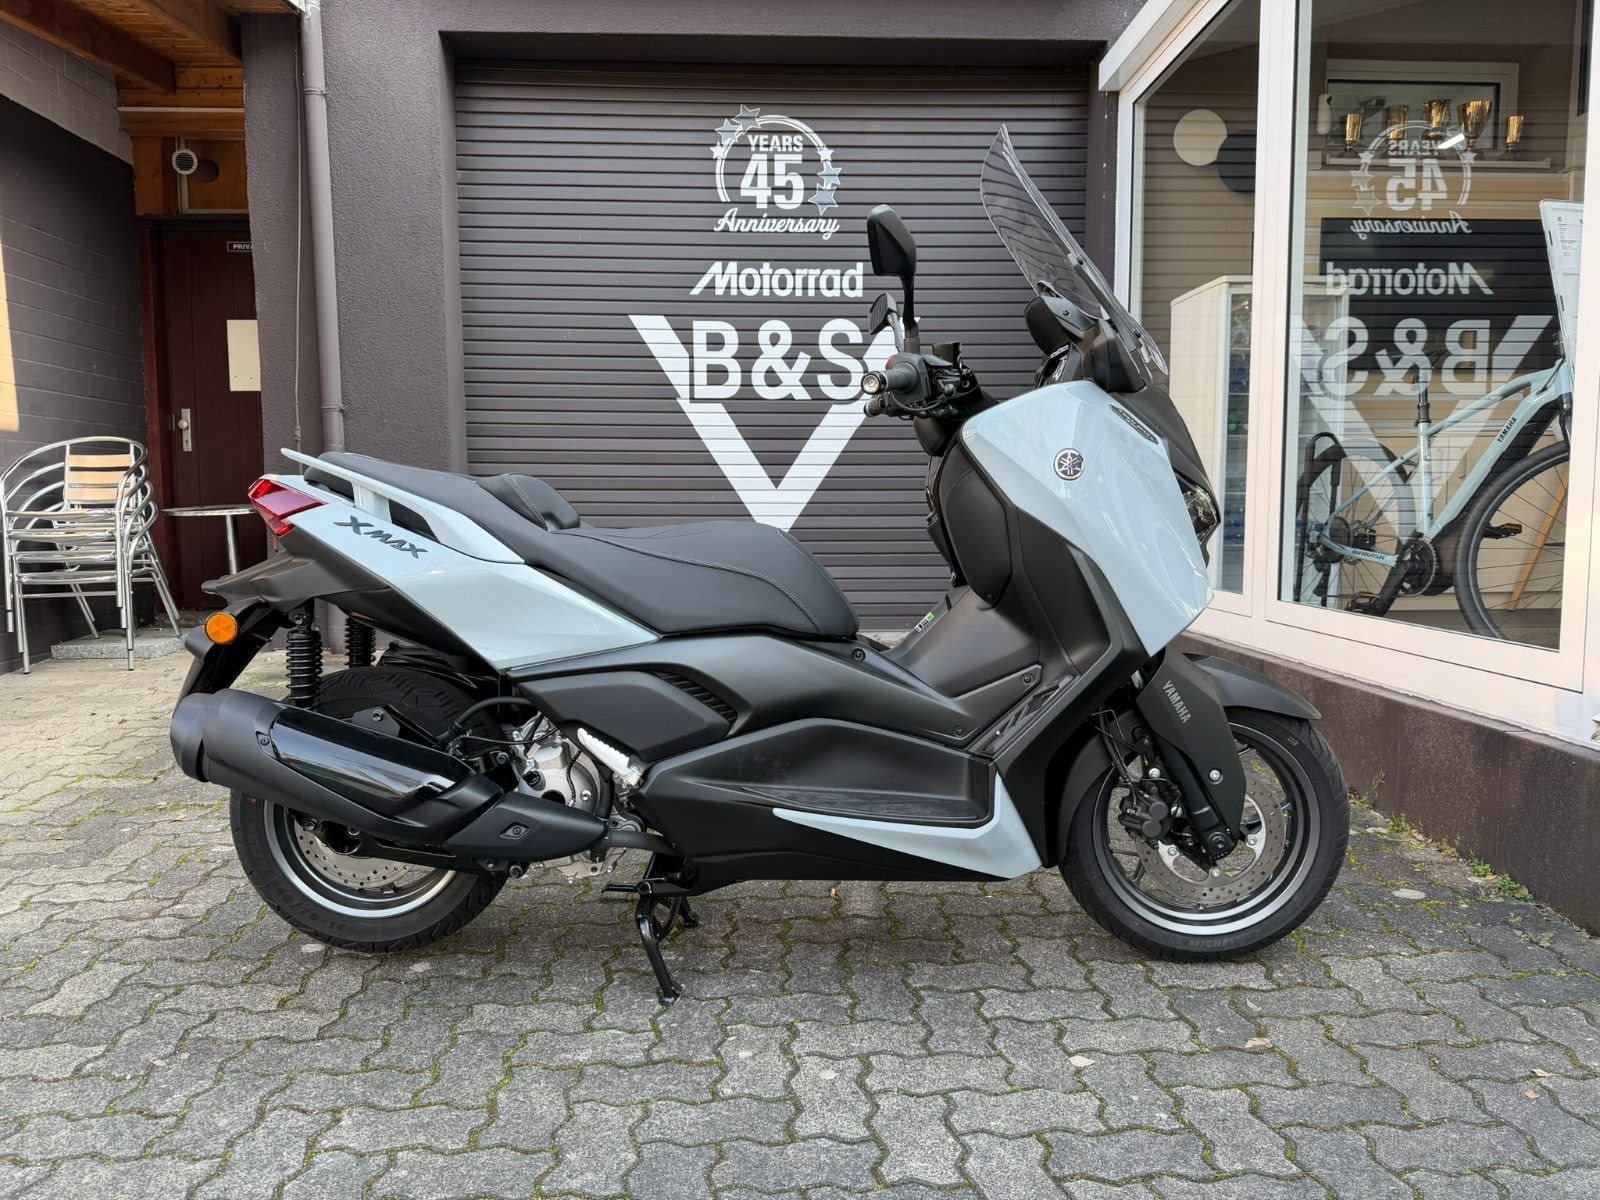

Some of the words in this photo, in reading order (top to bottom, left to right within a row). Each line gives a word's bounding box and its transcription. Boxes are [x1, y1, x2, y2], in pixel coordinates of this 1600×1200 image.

[748, 134, 804, 152] YEARS
[740, 153, 805, 210] 45
[713, 207, 840, 240] Anniversary
[690, 261, 864, 297] Motorrad
[691, 318, 865, 400] B&S
[1497, 416, 1517, 442] YAMAHA
[1162, 679, 1191, 724] YAMAHA
